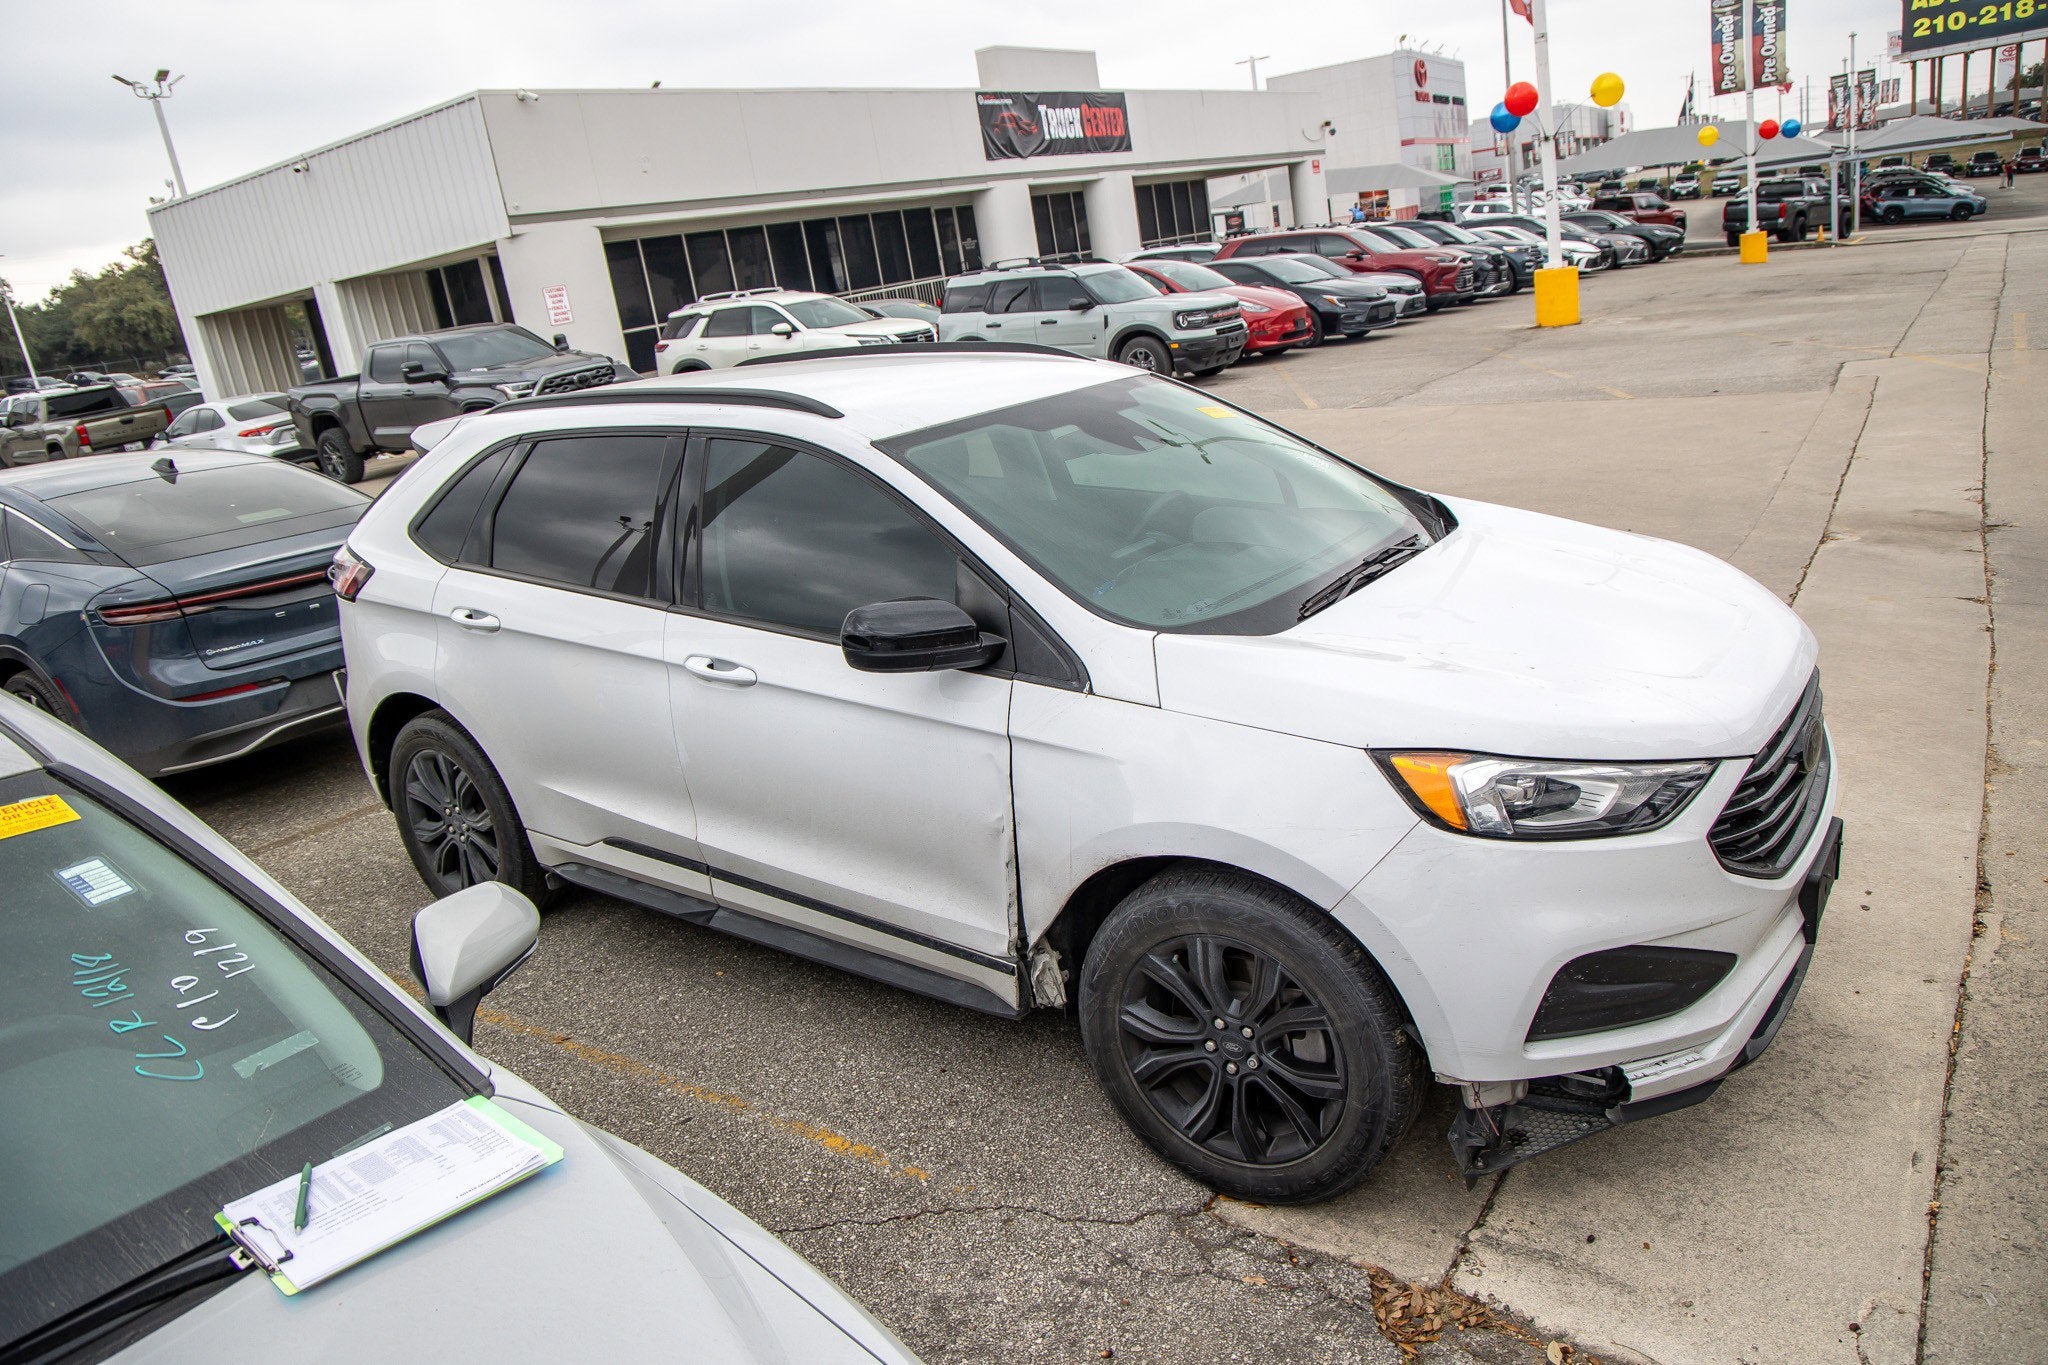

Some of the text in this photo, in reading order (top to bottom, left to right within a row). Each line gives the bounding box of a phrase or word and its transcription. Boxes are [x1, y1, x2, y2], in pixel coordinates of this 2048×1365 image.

[1719, 14, 1736, 65] Owned
[1760, 5, 1777, 83] Pre Owned
[1720, 64, 1737, 90] Pre
[1037, 103, 1126, 140] TRUCK CENTER
[1546, 189, 1554, 202] 5
[0, 798, 57, 815] EHICLE
